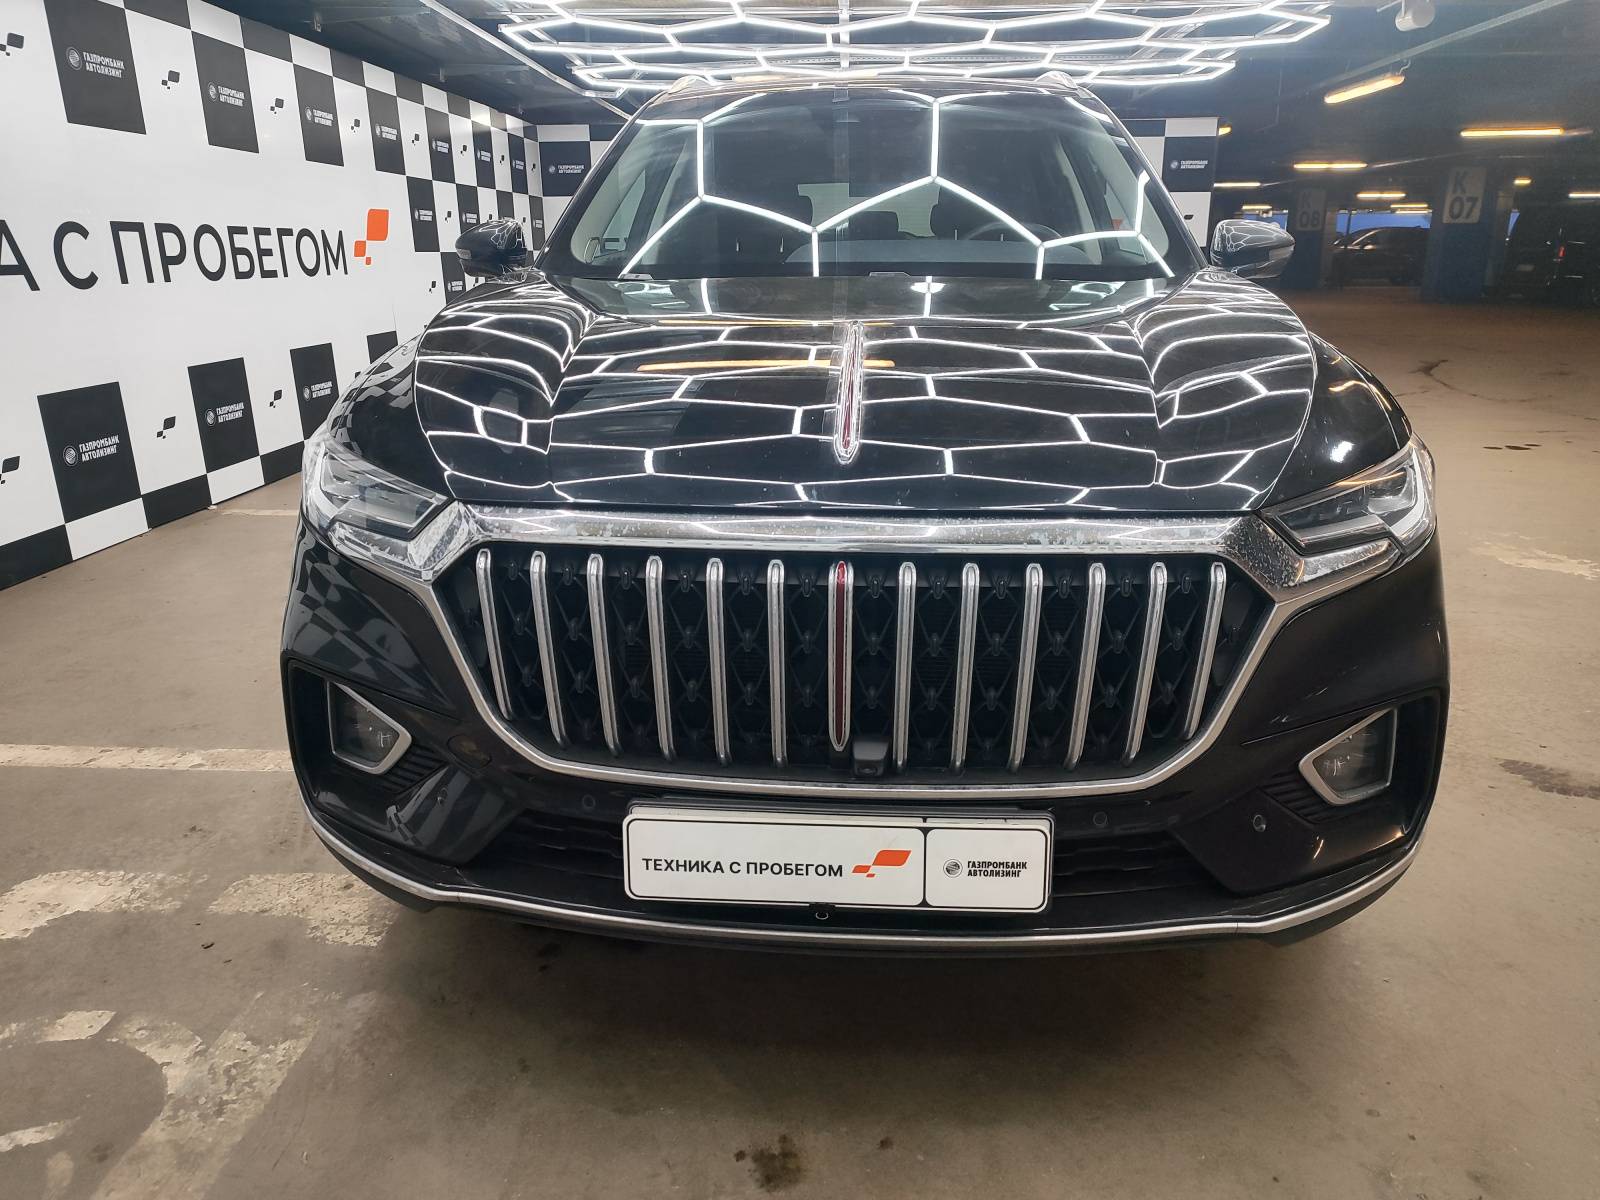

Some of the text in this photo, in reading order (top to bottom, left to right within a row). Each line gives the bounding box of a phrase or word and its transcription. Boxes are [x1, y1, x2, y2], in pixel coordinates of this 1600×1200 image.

[83, 52, 125, 70] ГАЗПРОМБАНК
[85, 62, 122, 78] АВТОЛИЗИНГ
[1449, 196, 1478, 220] 07
[1299, 210, 1321, 228] 08
[53, 221, 98, 290] С
[110, 221, 348, 285] ПРОБЕГОМ
[79, 435, 119, 452] ГАЗПРОМБАНК
[81, 445, 117, 462] АВТОЛИЗИНГ
[642, 858, 843, 877] ТЕХНИКА С ПРОБЕГОМ
[967, 861, 1027, 869] ГАЗПРОМБАНК
[967, 869, 1021, 877] АВТОЛИЗИНГ
